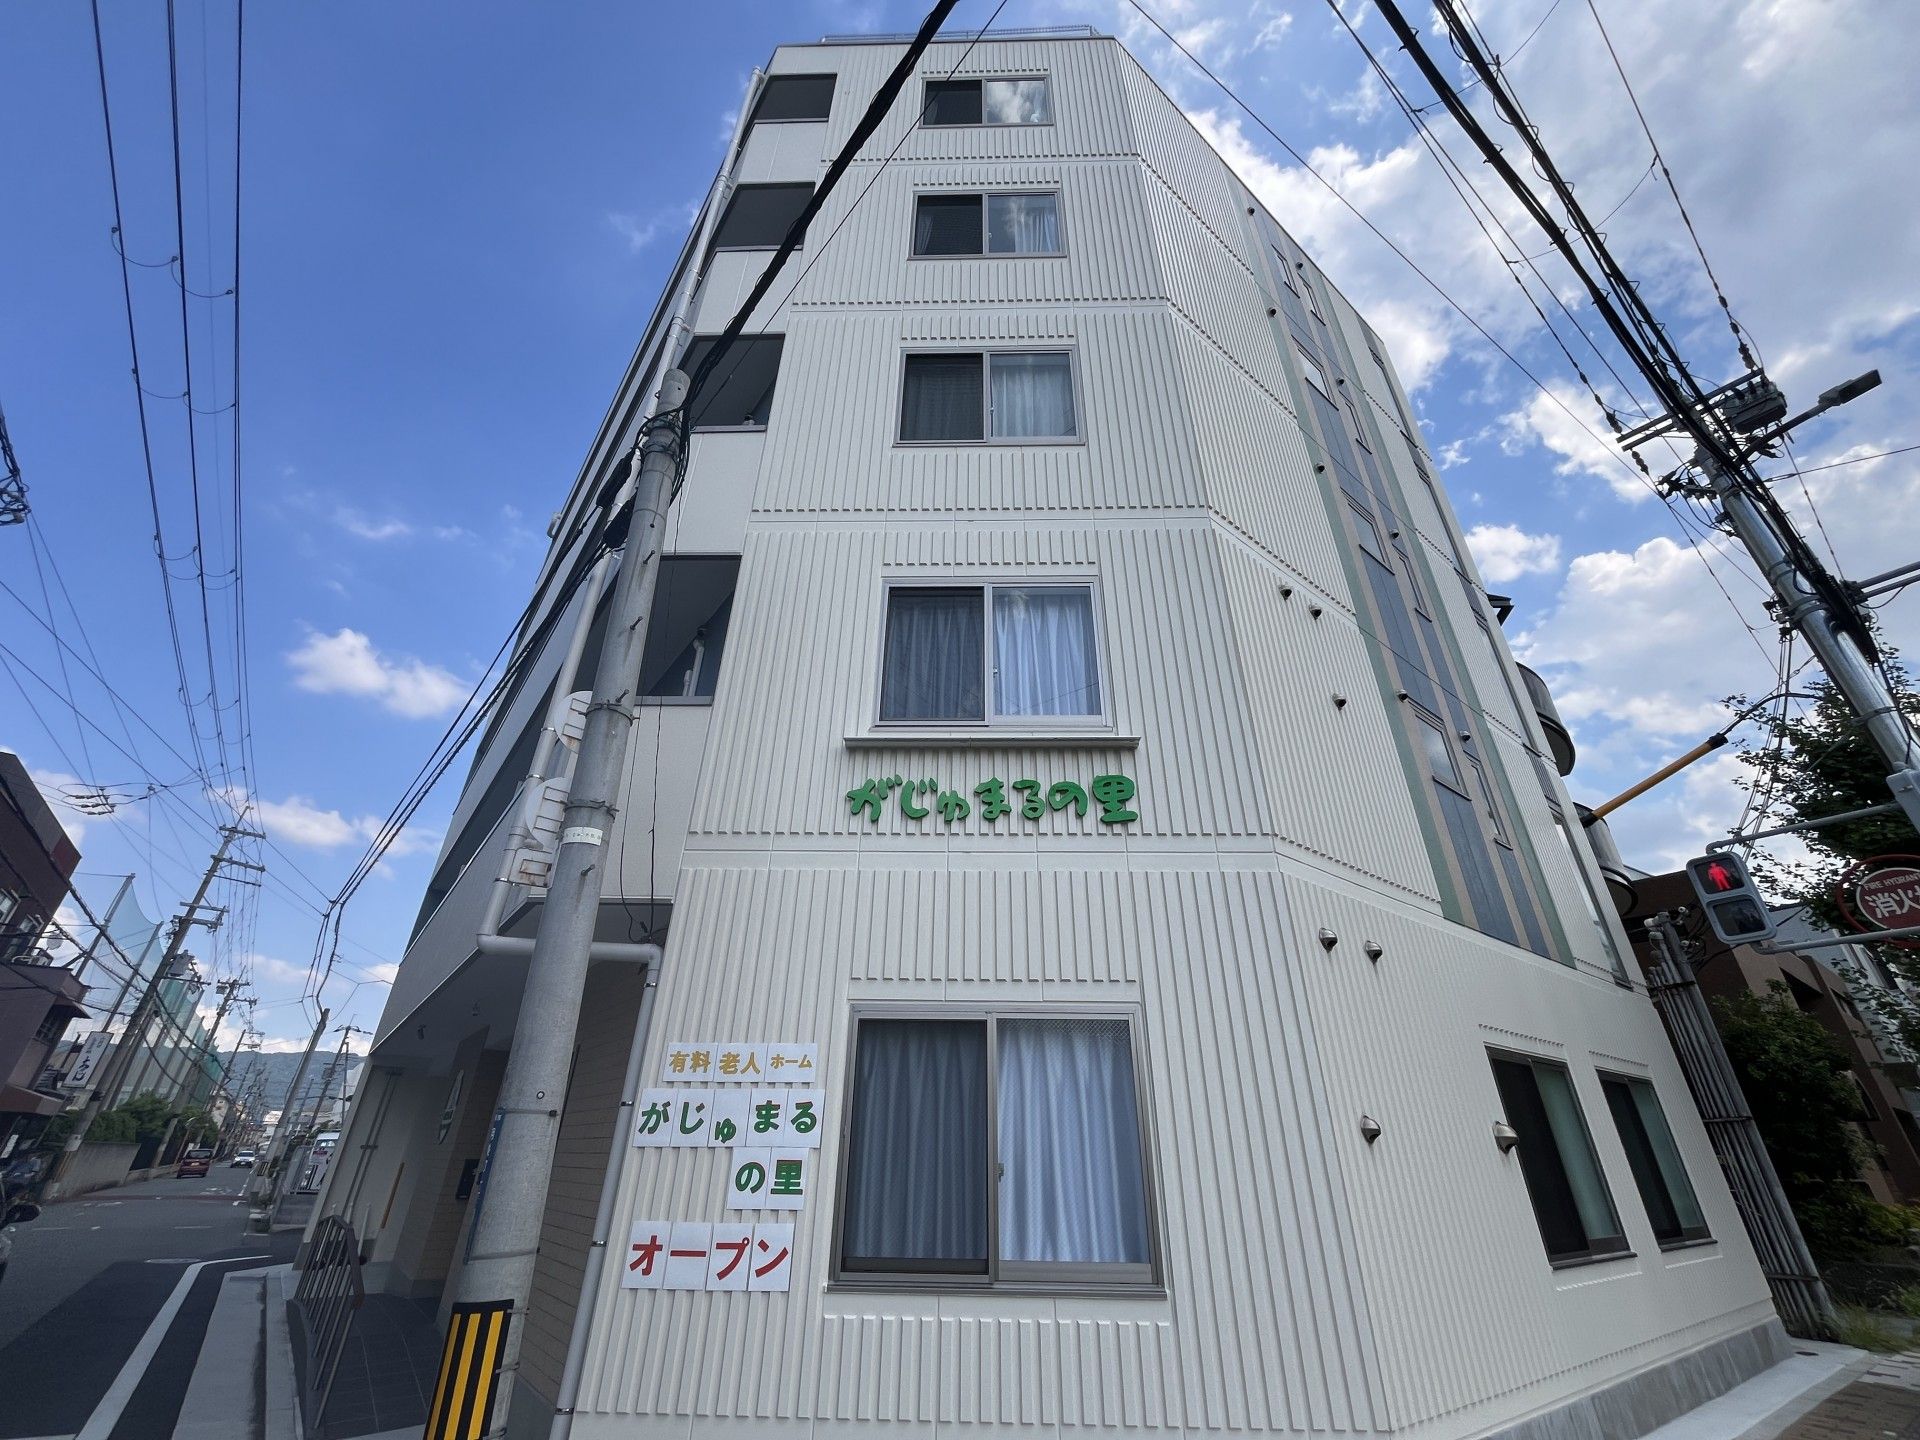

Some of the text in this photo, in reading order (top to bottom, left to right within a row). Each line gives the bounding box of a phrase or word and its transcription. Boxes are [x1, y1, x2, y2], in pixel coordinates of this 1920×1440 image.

[846, 774, 1139, 824] がじゅまるの里
[1863, 880, 1884, 890] FIRE
[638, 1100, 817, 1144] がじゅまる
[735, 1159, 803, 1195] の里
[629, 1234, 789, 1281] オープン
